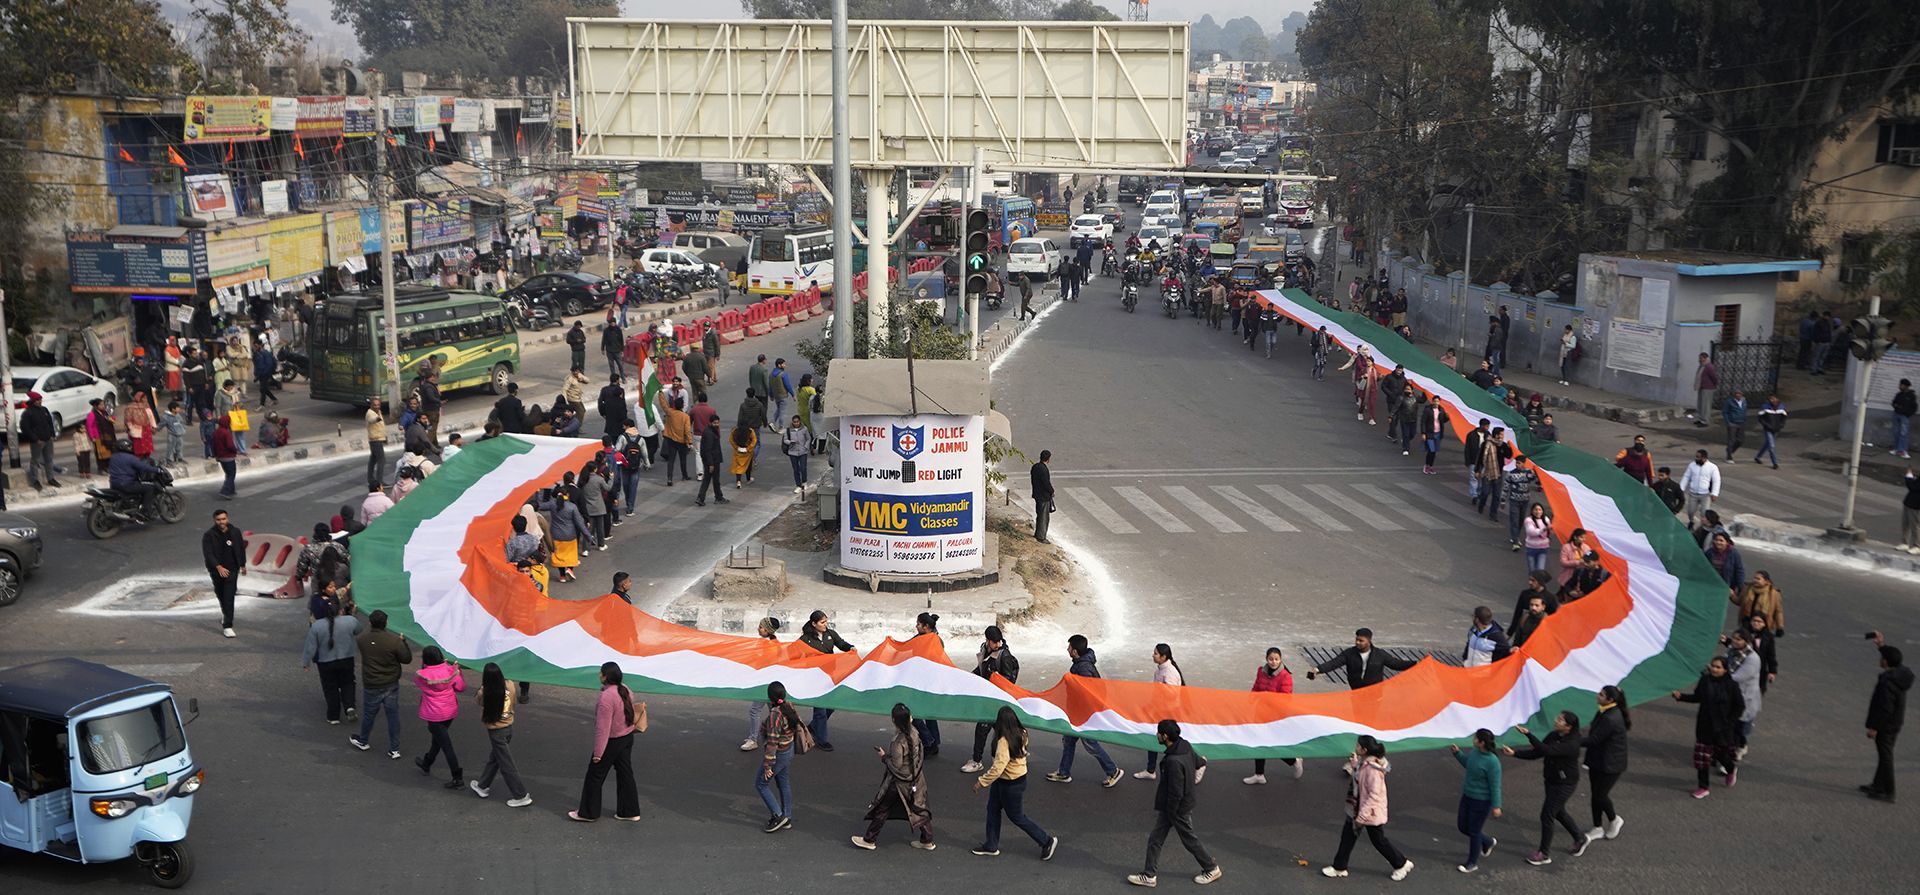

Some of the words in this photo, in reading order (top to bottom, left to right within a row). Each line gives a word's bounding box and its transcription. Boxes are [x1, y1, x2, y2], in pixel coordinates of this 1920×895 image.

[850, 424, 886, 439] TRAFFIC
[932, 426, 965, 440] POLICE
[854, 439, 874, 452] CITY
[931, 441, 968, 454] JAMMU
[853, 466, 874, 479] DONT
[876, 469, 901, 480] JUMP
[918, 470, 936, 481] RED
[937, 468, 963, 480] LIGHT
[853, 500, 908, 529] VMC
[910, 499, 970, 515] Vidyamandir
[920, 517, 959, 529] Classes
